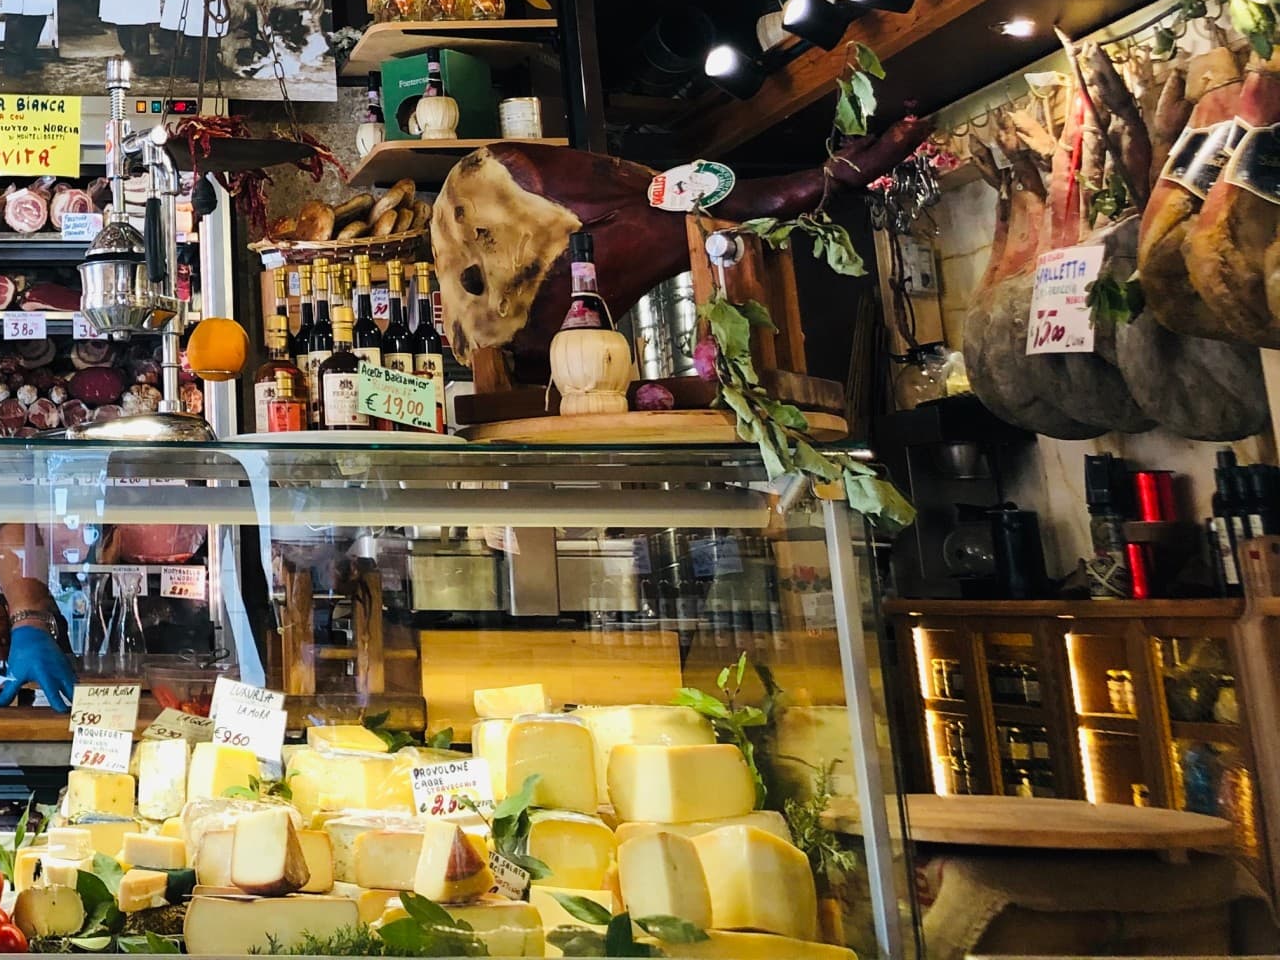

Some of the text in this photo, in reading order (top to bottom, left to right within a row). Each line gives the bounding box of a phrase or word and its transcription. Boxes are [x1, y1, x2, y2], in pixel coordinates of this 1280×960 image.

[17, 96, 66, 113] BIANCA
[44, 123, 79, 134] NORCIA
[364, 393, 378, 412] €
[413, 761, 469, 780] PROVOLONE
